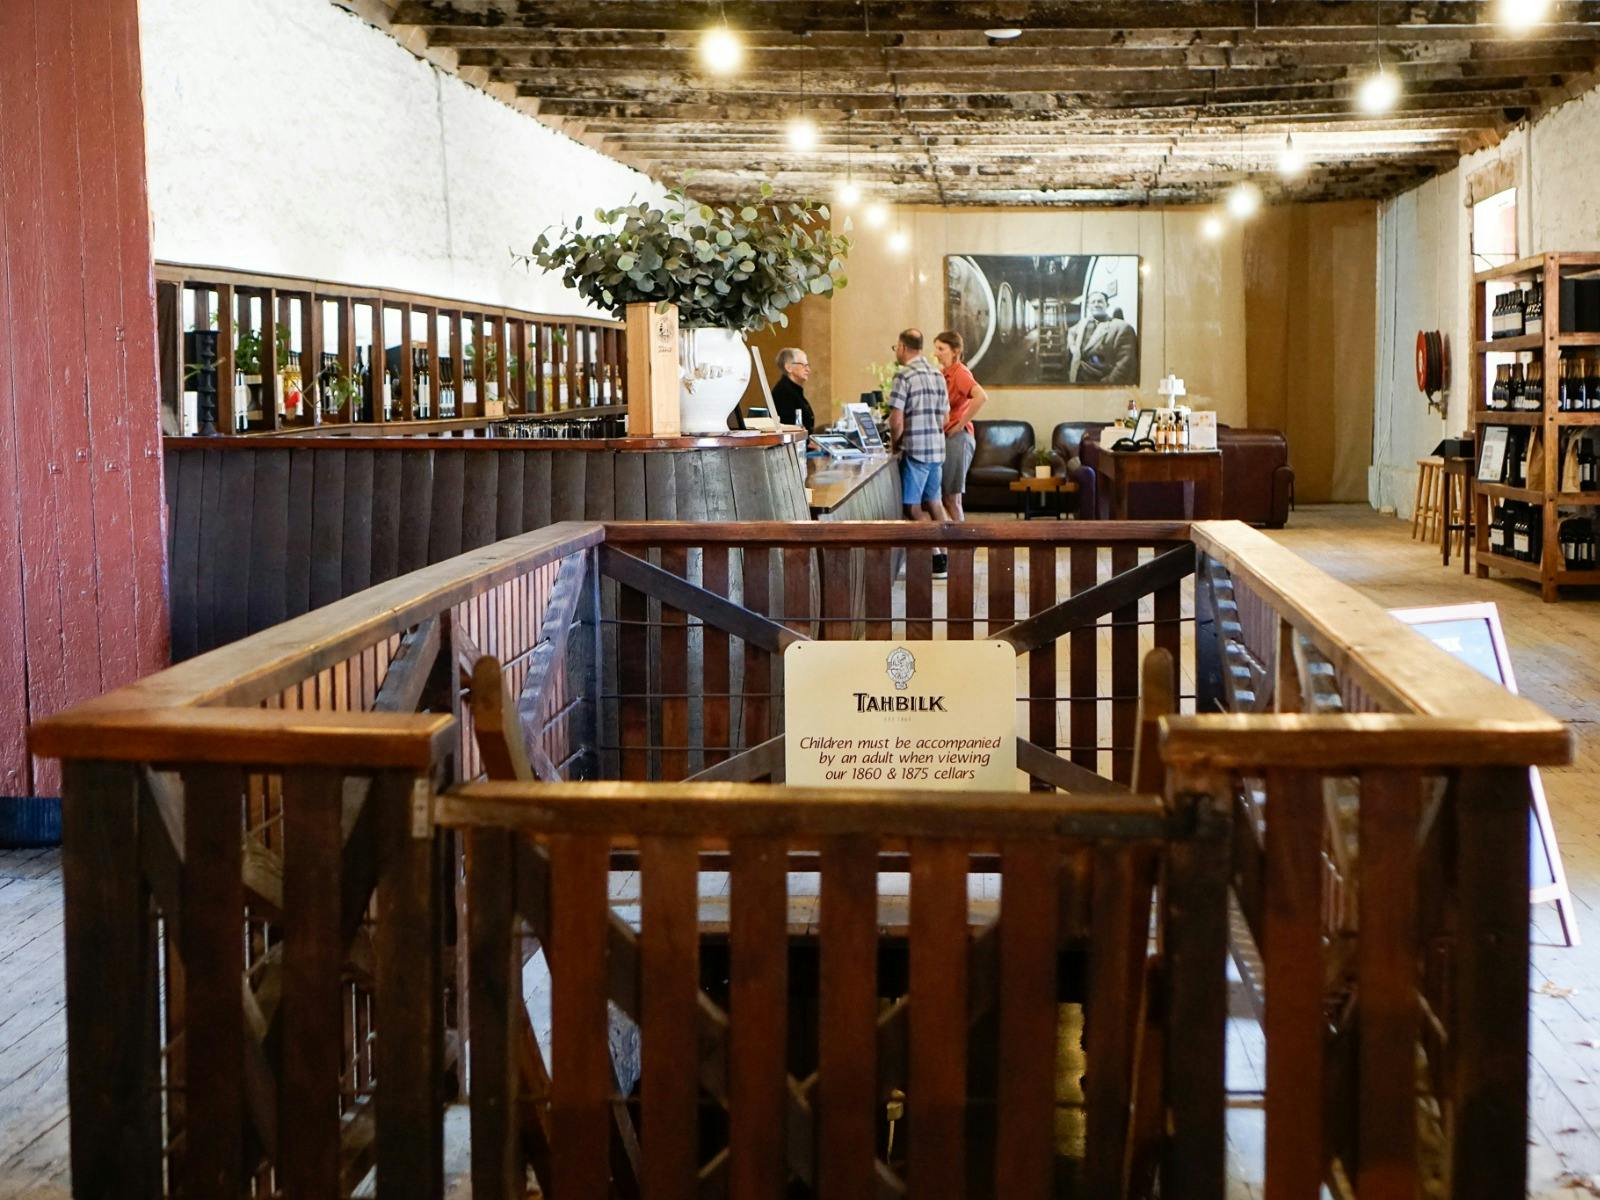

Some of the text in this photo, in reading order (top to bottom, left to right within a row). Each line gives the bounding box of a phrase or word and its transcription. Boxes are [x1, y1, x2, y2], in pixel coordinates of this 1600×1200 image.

[853, 692, 947, 713] TAHBILK
[800, 736, 1001, 753] Children must be accompanied
[819, 751, 990, 766] by an adult when viewing
[825, 767, 975, 780] our 1860 & 1875 cellars
